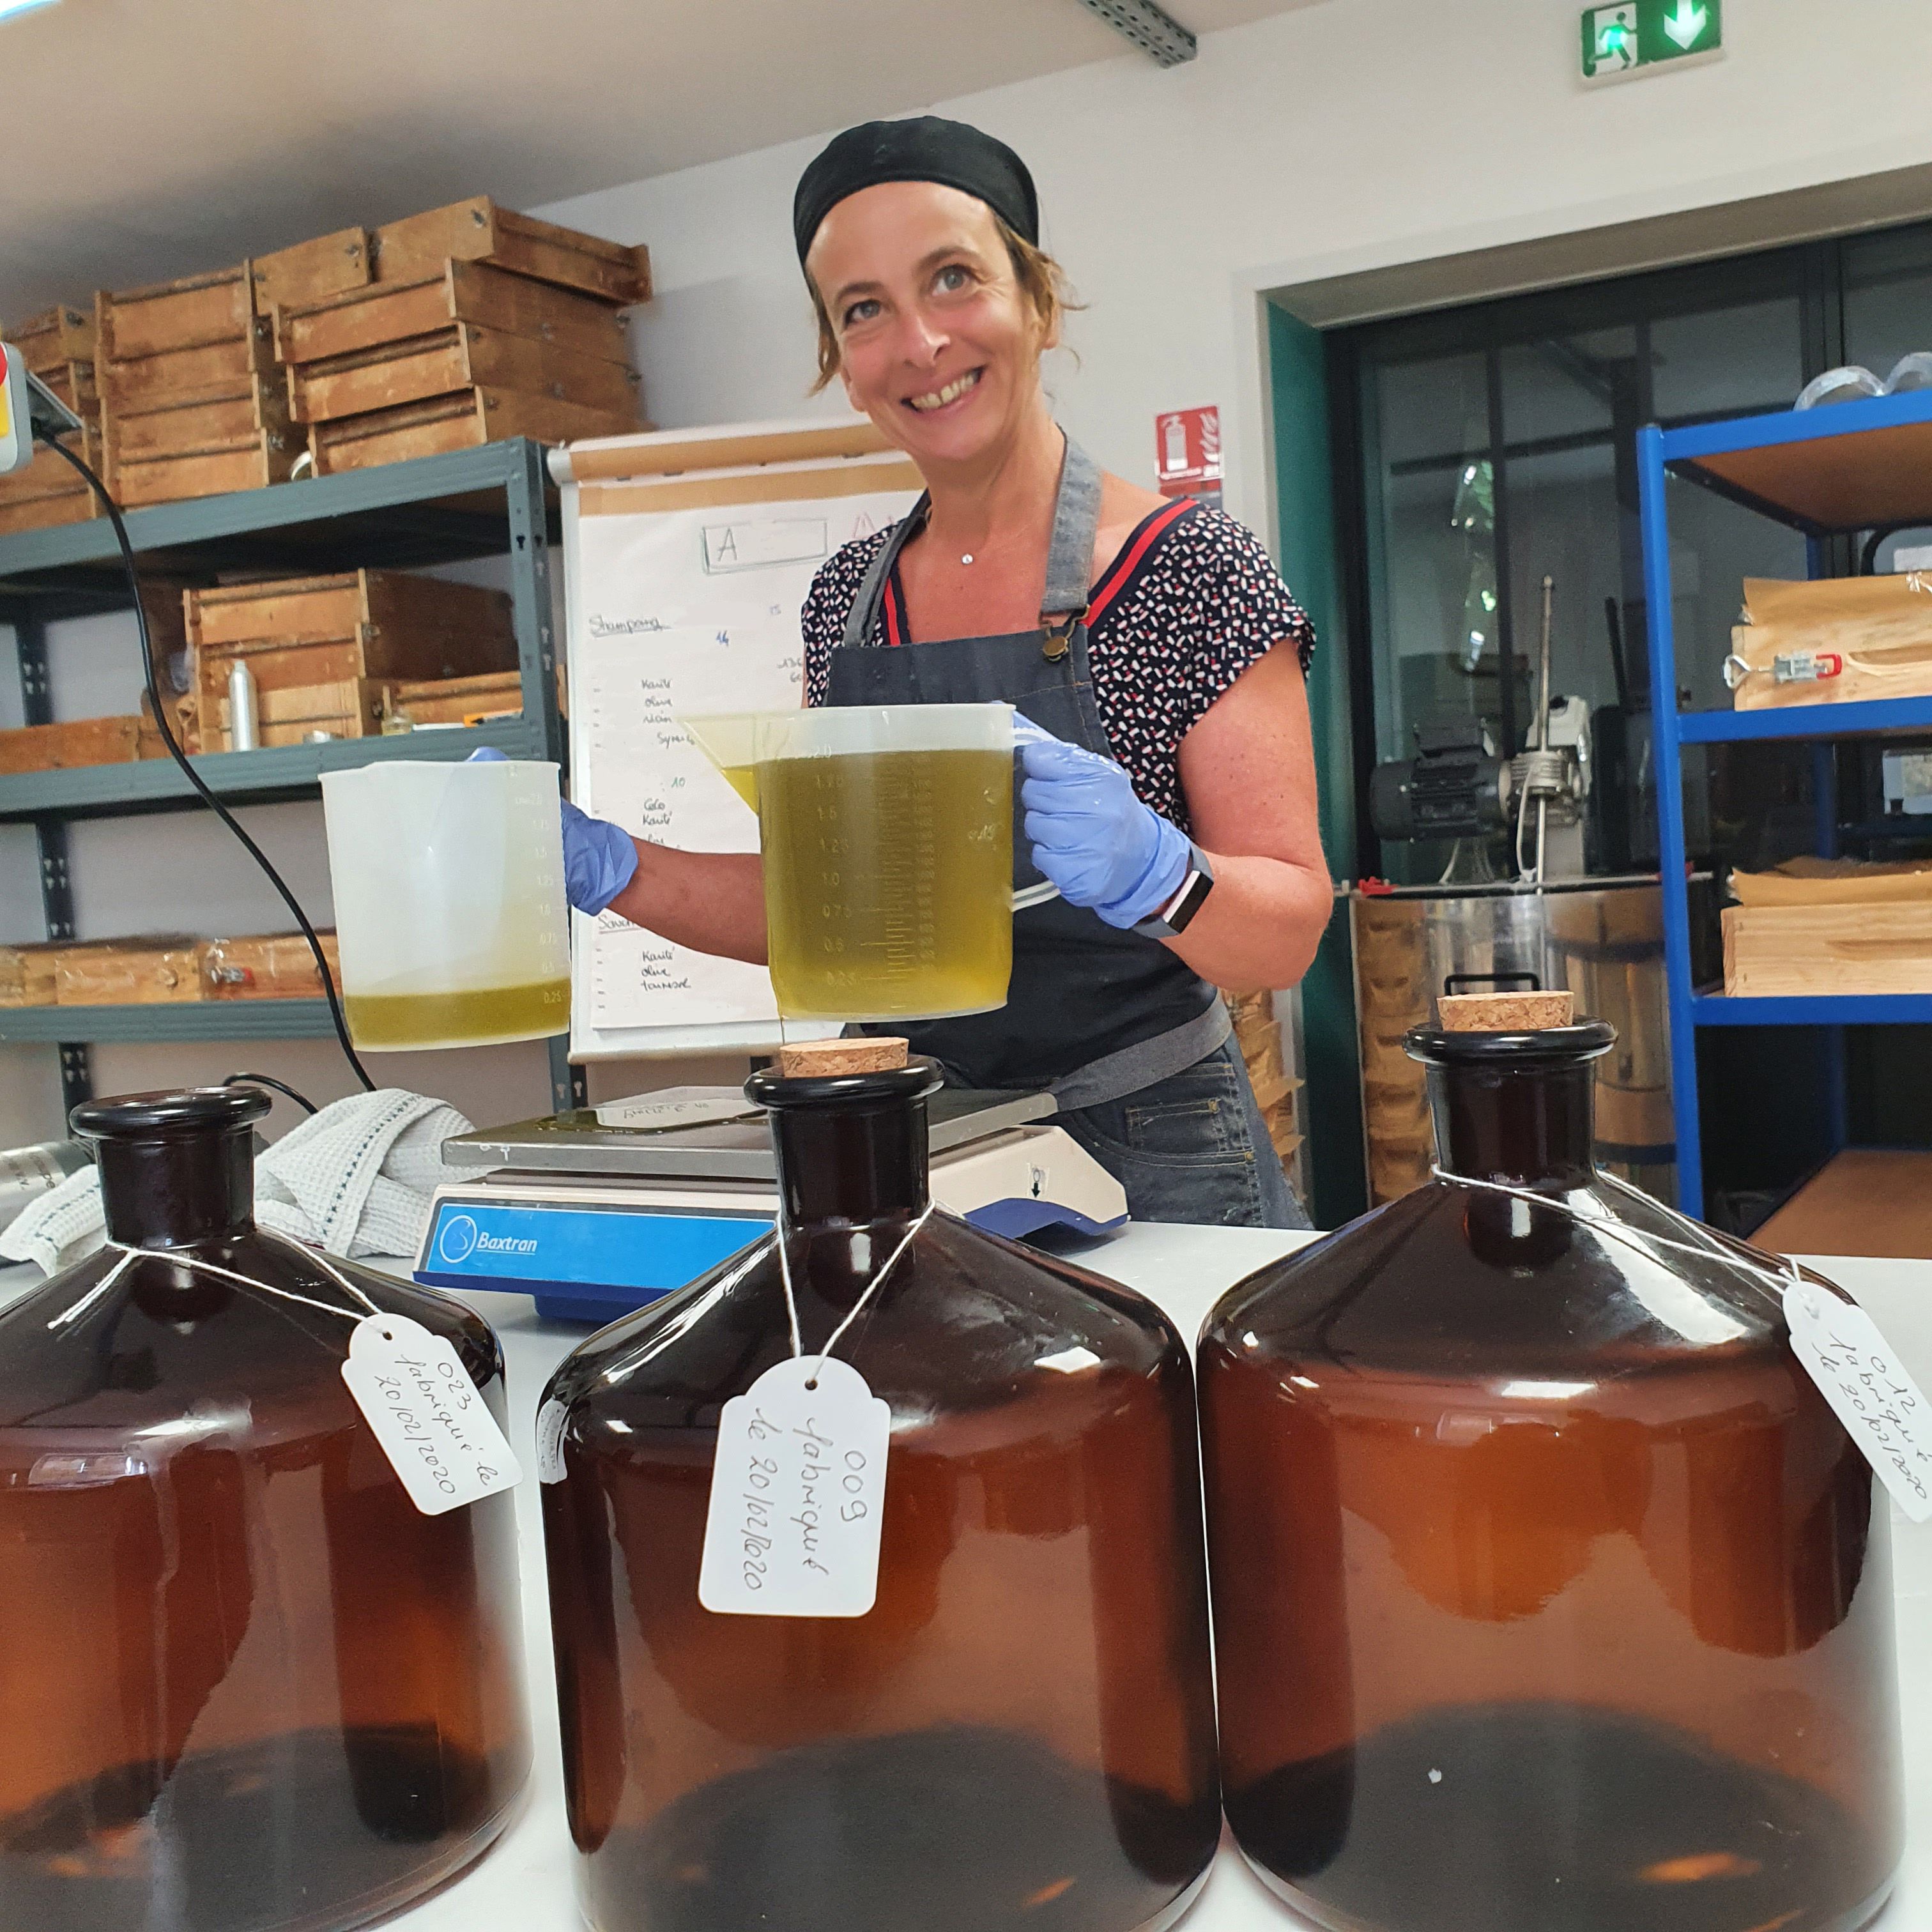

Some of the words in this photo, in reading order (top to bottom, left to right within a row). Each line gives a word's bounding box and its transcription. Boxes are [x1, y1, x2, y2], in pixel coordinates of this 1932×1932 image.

[717, 528, 737, 562] A
[544, 990, 562, 1003] 0.25
[477, 1232, 537, 1253] Baxtran
[437, 1362, 471, 1410] 023
[840, 1450, 867, 1522] 009
